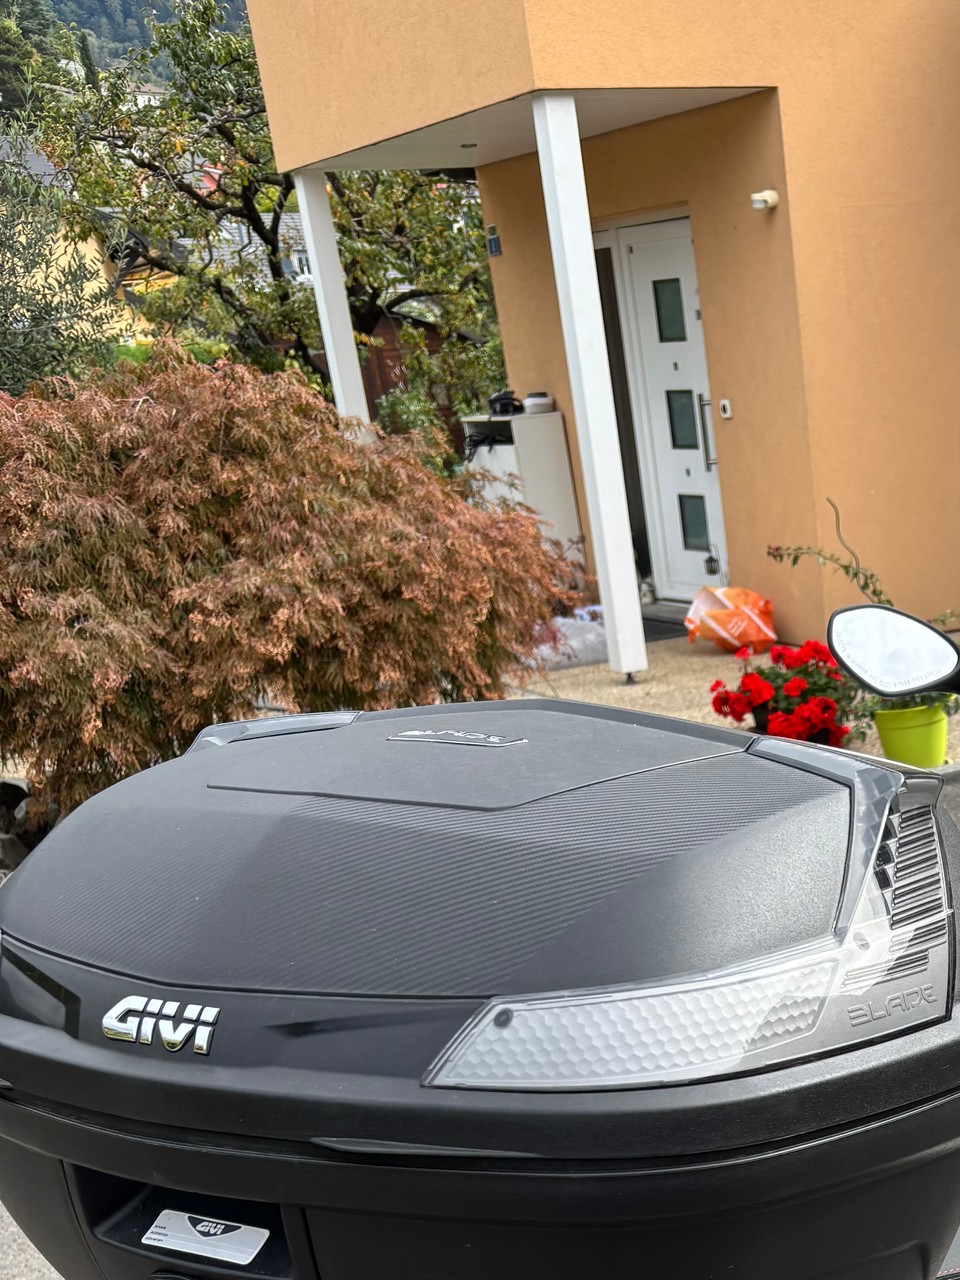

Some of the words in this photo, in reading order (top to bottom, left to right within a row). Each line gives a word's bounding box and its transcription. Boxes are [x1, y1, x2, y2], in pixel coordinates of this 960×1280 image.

[102, 995, 220, 1056] GIVI
[847, 983, 937, 1027] BLADE
[195, 1221, 225, 1235] GIVI
